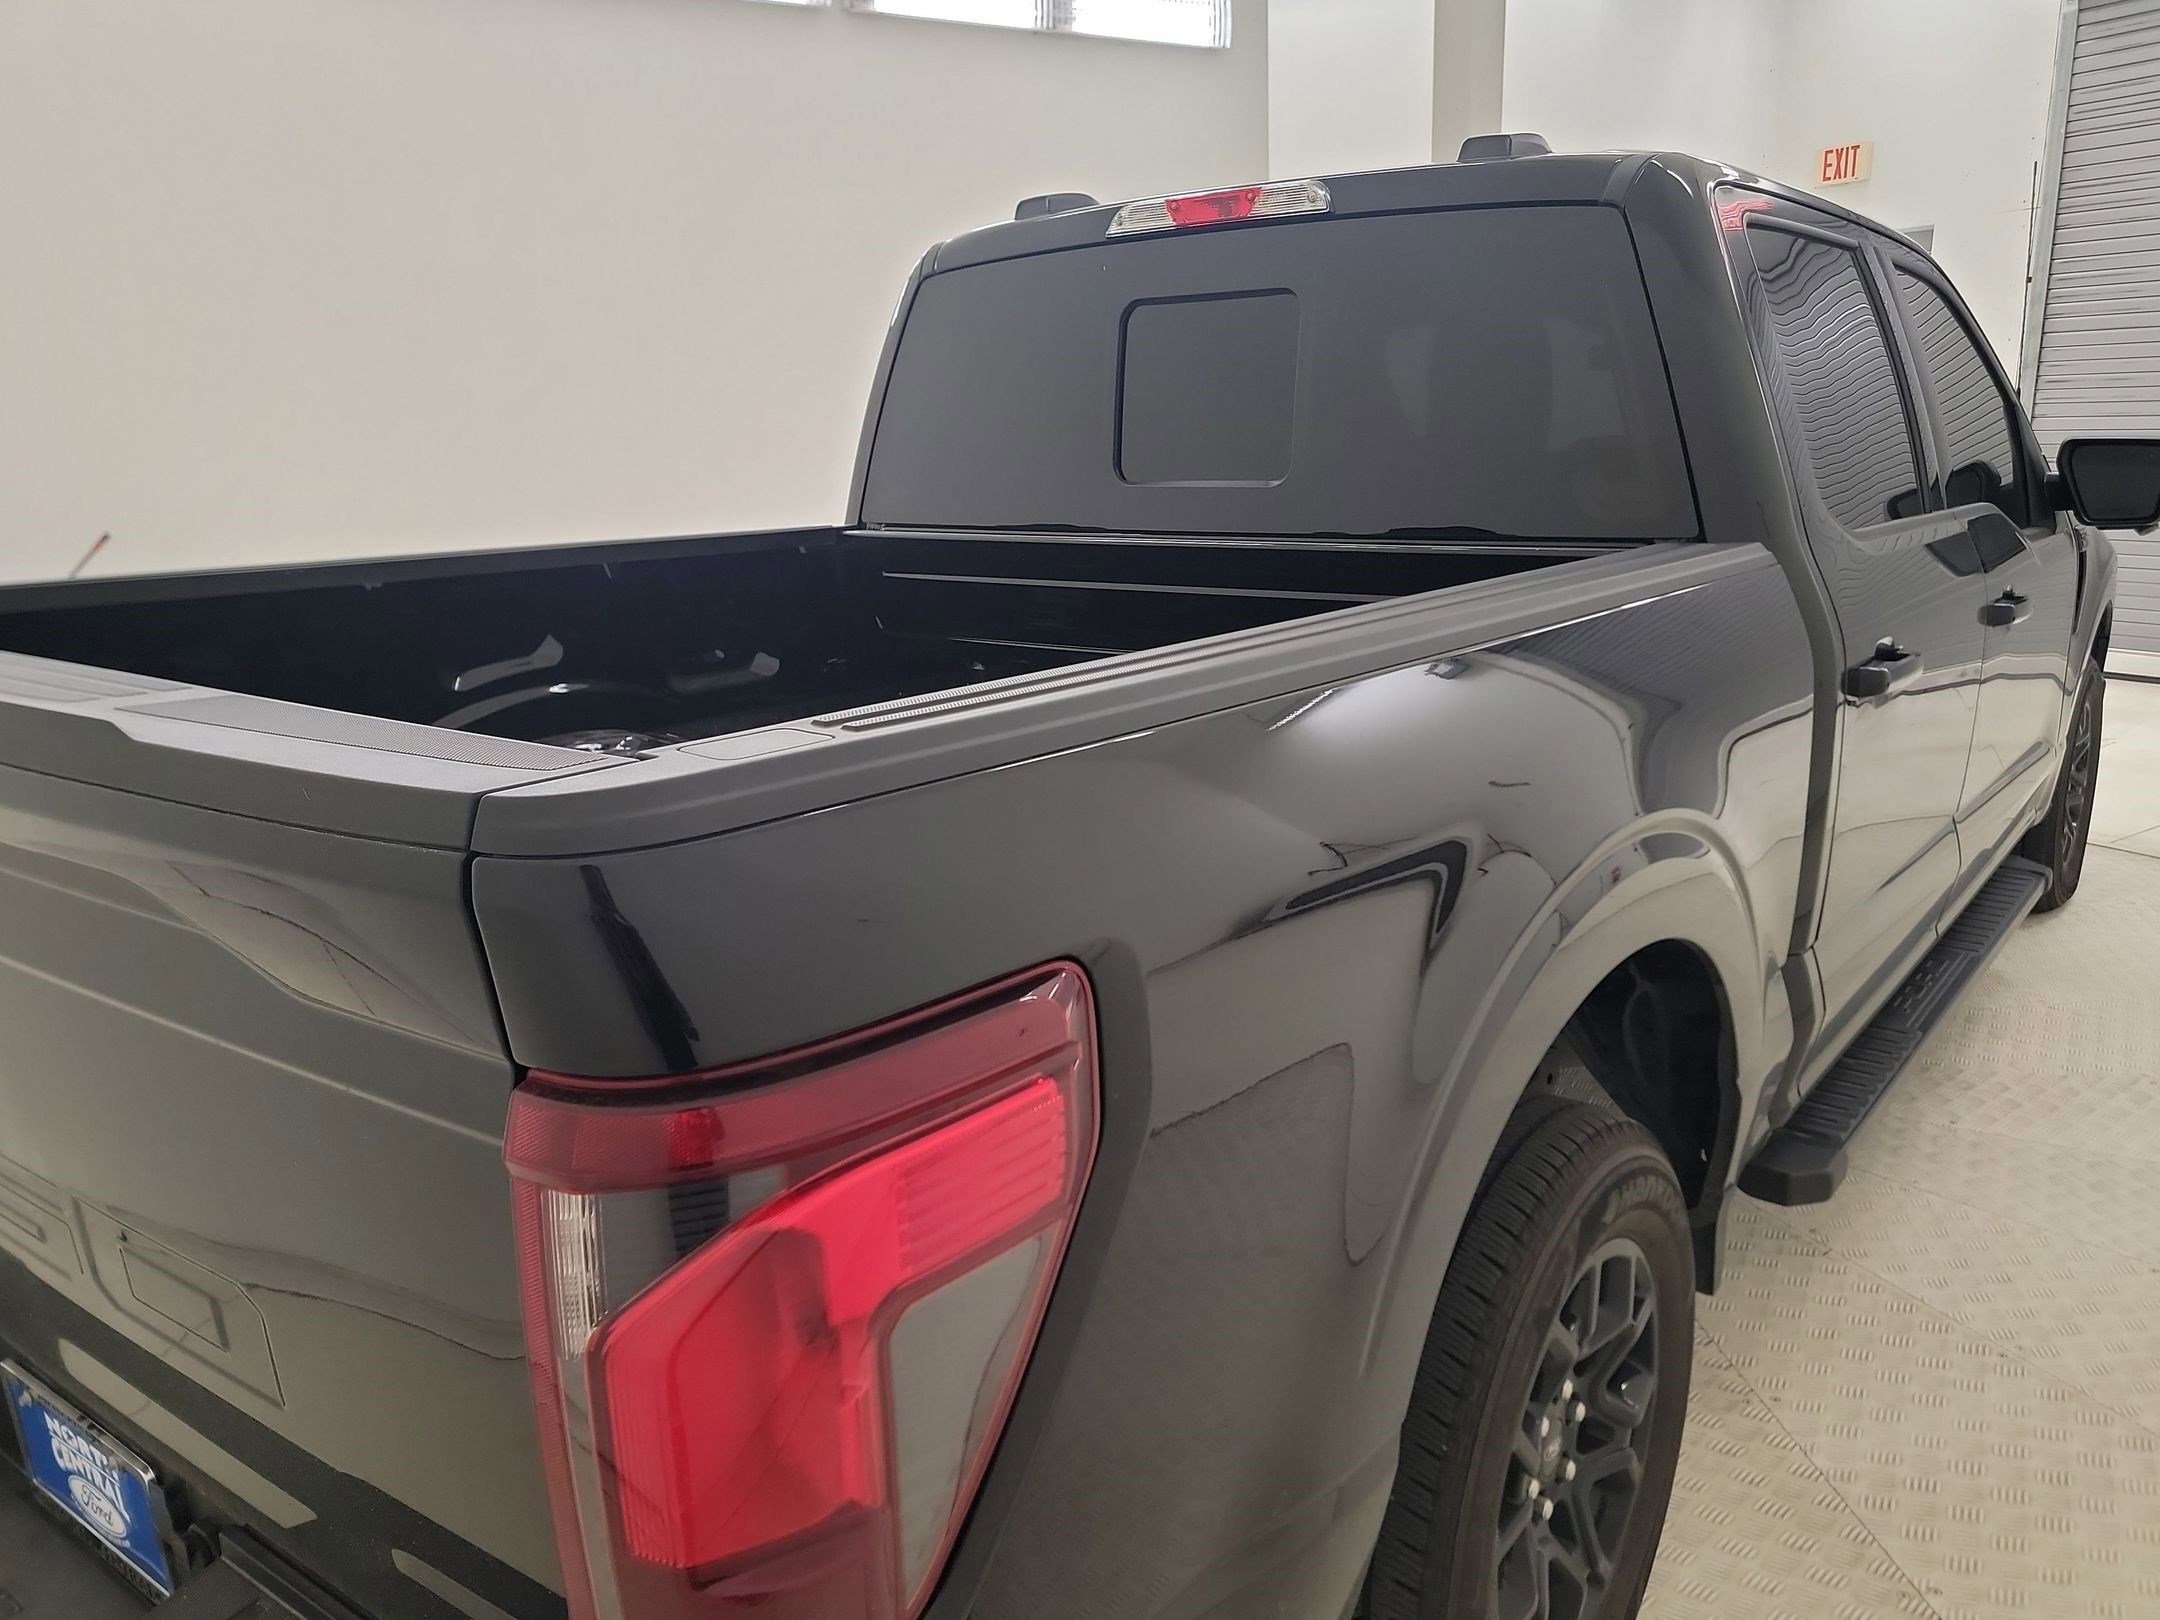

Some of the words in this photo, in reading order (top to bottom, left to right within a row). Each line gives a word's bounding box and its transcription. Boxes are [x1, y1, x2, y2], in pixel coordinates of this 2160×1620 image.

[1822, 144, 1860, 182] EXIT
[51, 1437, 130, 1523] CENTRAL
[81, 1484, 114, 1526] Ford
